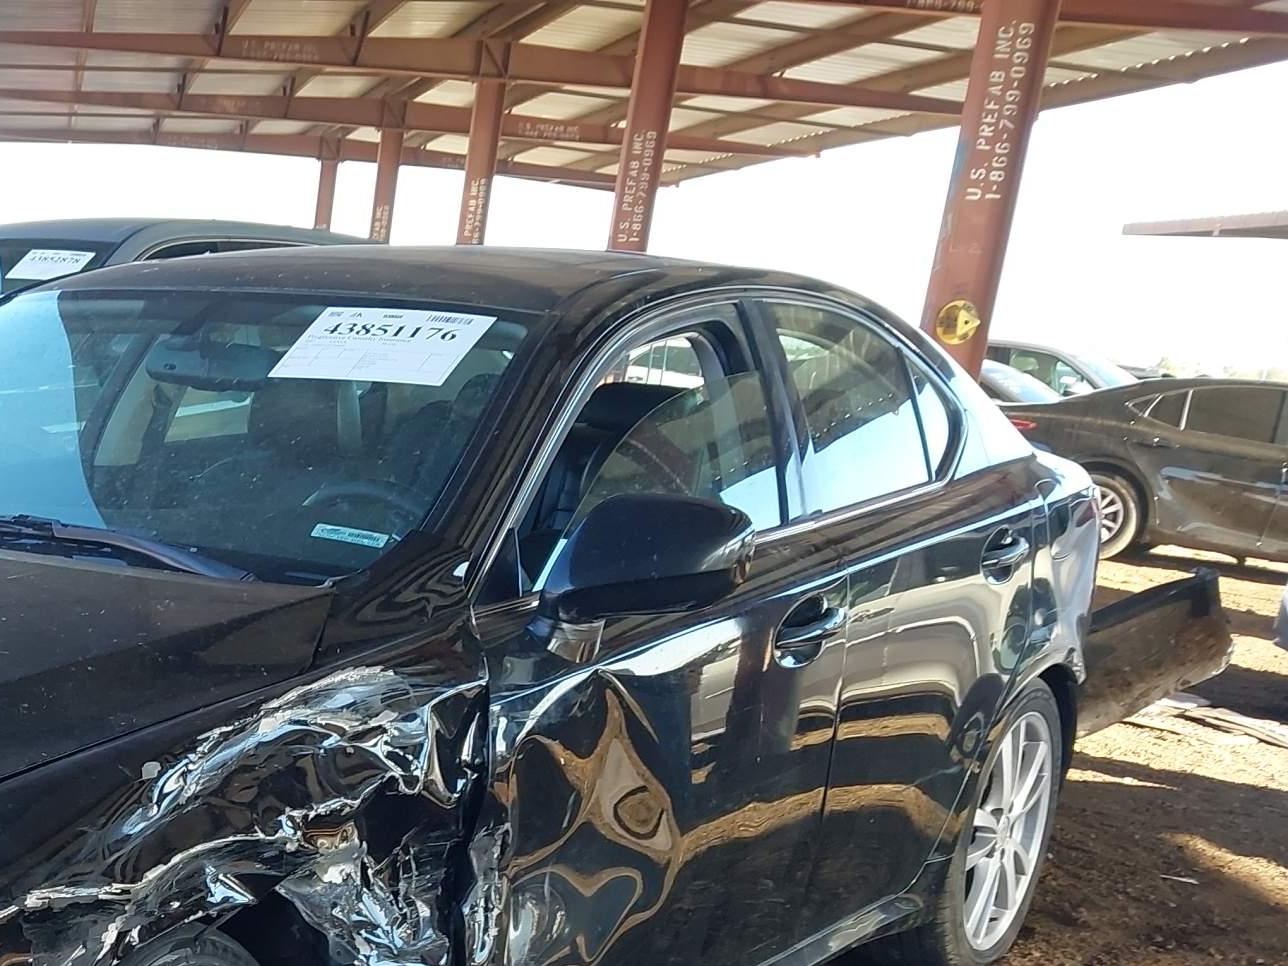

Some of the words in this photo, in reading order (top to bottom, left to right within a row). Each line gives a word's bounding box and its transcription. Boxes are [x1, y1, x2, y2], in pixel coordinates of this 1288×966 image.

[993, 19, 1017, 59] INC.
[976, 70, 1006, 151] PREFAB
[985, 22, 1035, 200] 1-866-799-0969
[622, 160, 640, 211] PREFAB
[629, 131, 657, 243] 1-866-799-0969
[965, 162, 988, 201] U.S.
[323, 321, 457, 342] 43851176
